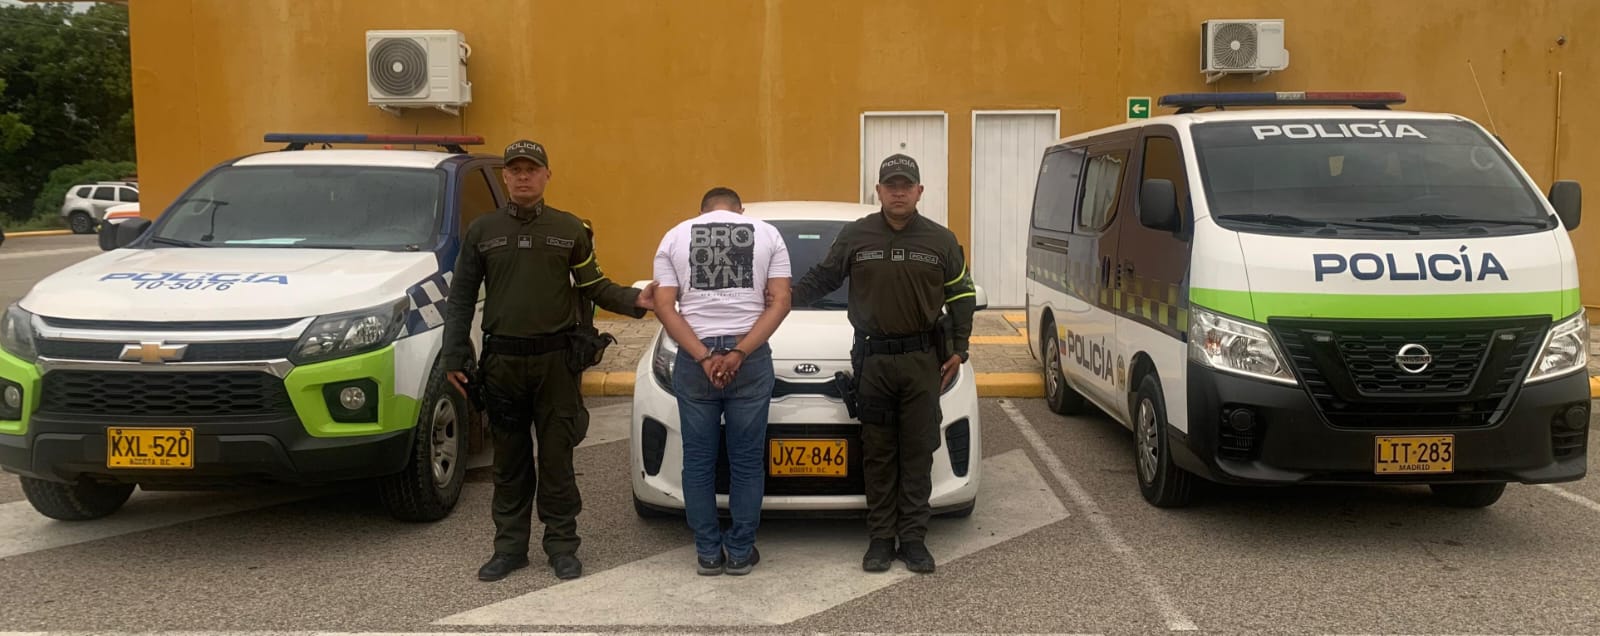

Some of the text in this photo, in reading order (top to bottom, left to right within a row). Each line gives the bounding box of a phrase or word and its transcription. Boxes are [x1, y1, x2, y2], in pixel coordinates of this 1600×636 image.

[1251, 119, 1428, 140] POLICÍA
[691, 226, 755, 248] BRO
[690, 246, 734, 266] OK
[1312, 244, 1510, 282] POLICÍA
[133, 281, 235, 292] 10-5076
[691, 265, 744, 288] LYN
[1067, 329, 1115, 386] POLICÍA
